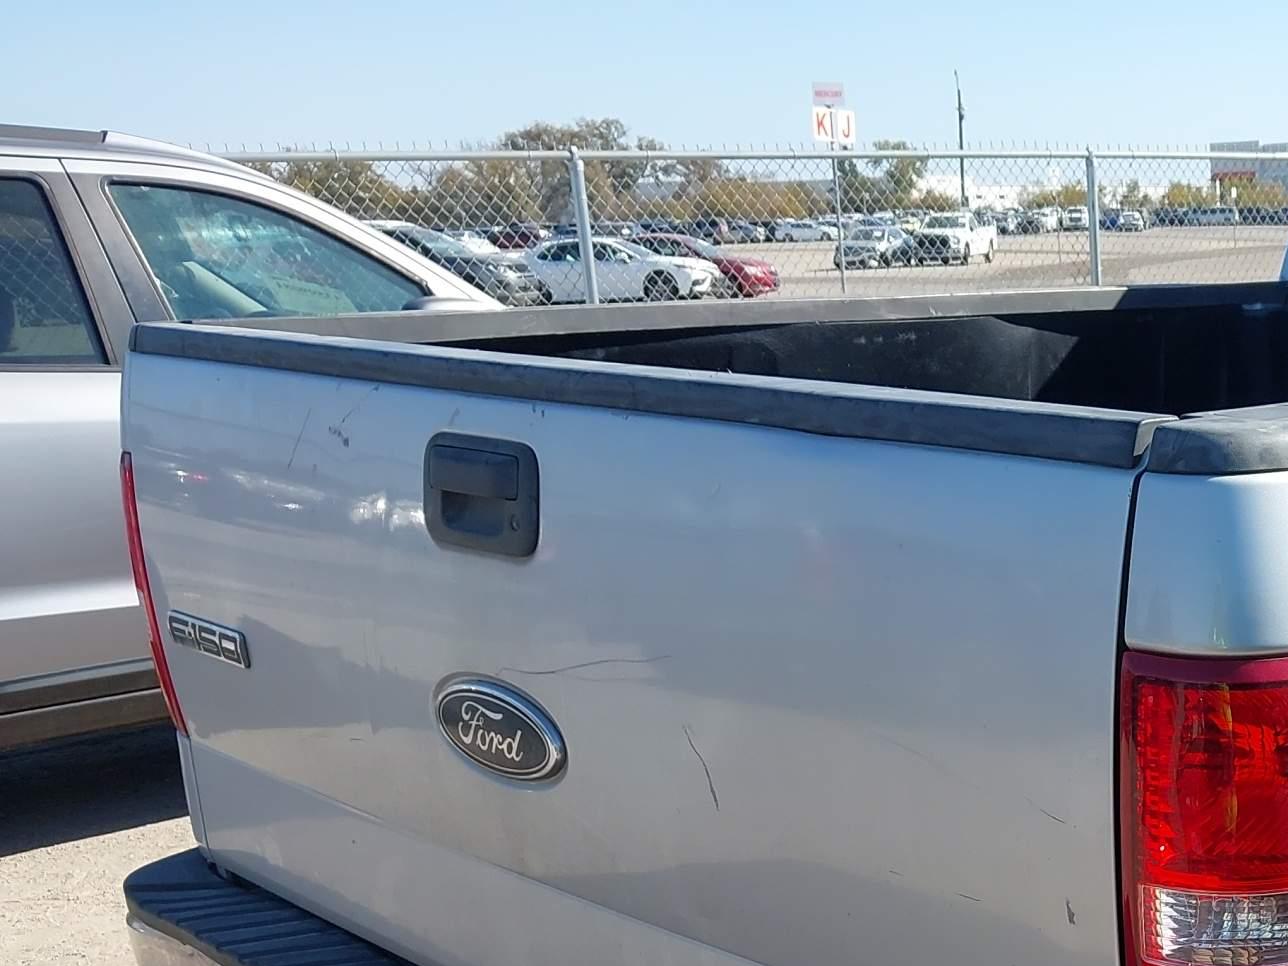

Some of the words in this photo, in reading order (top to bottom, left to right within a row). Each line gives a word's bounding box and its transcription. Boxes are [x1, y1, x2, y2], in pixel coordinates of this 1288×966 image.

[816, 111, 829, 136] K
[842, 114, 851, 138] J
[458, 701, 524, 761] Ford
